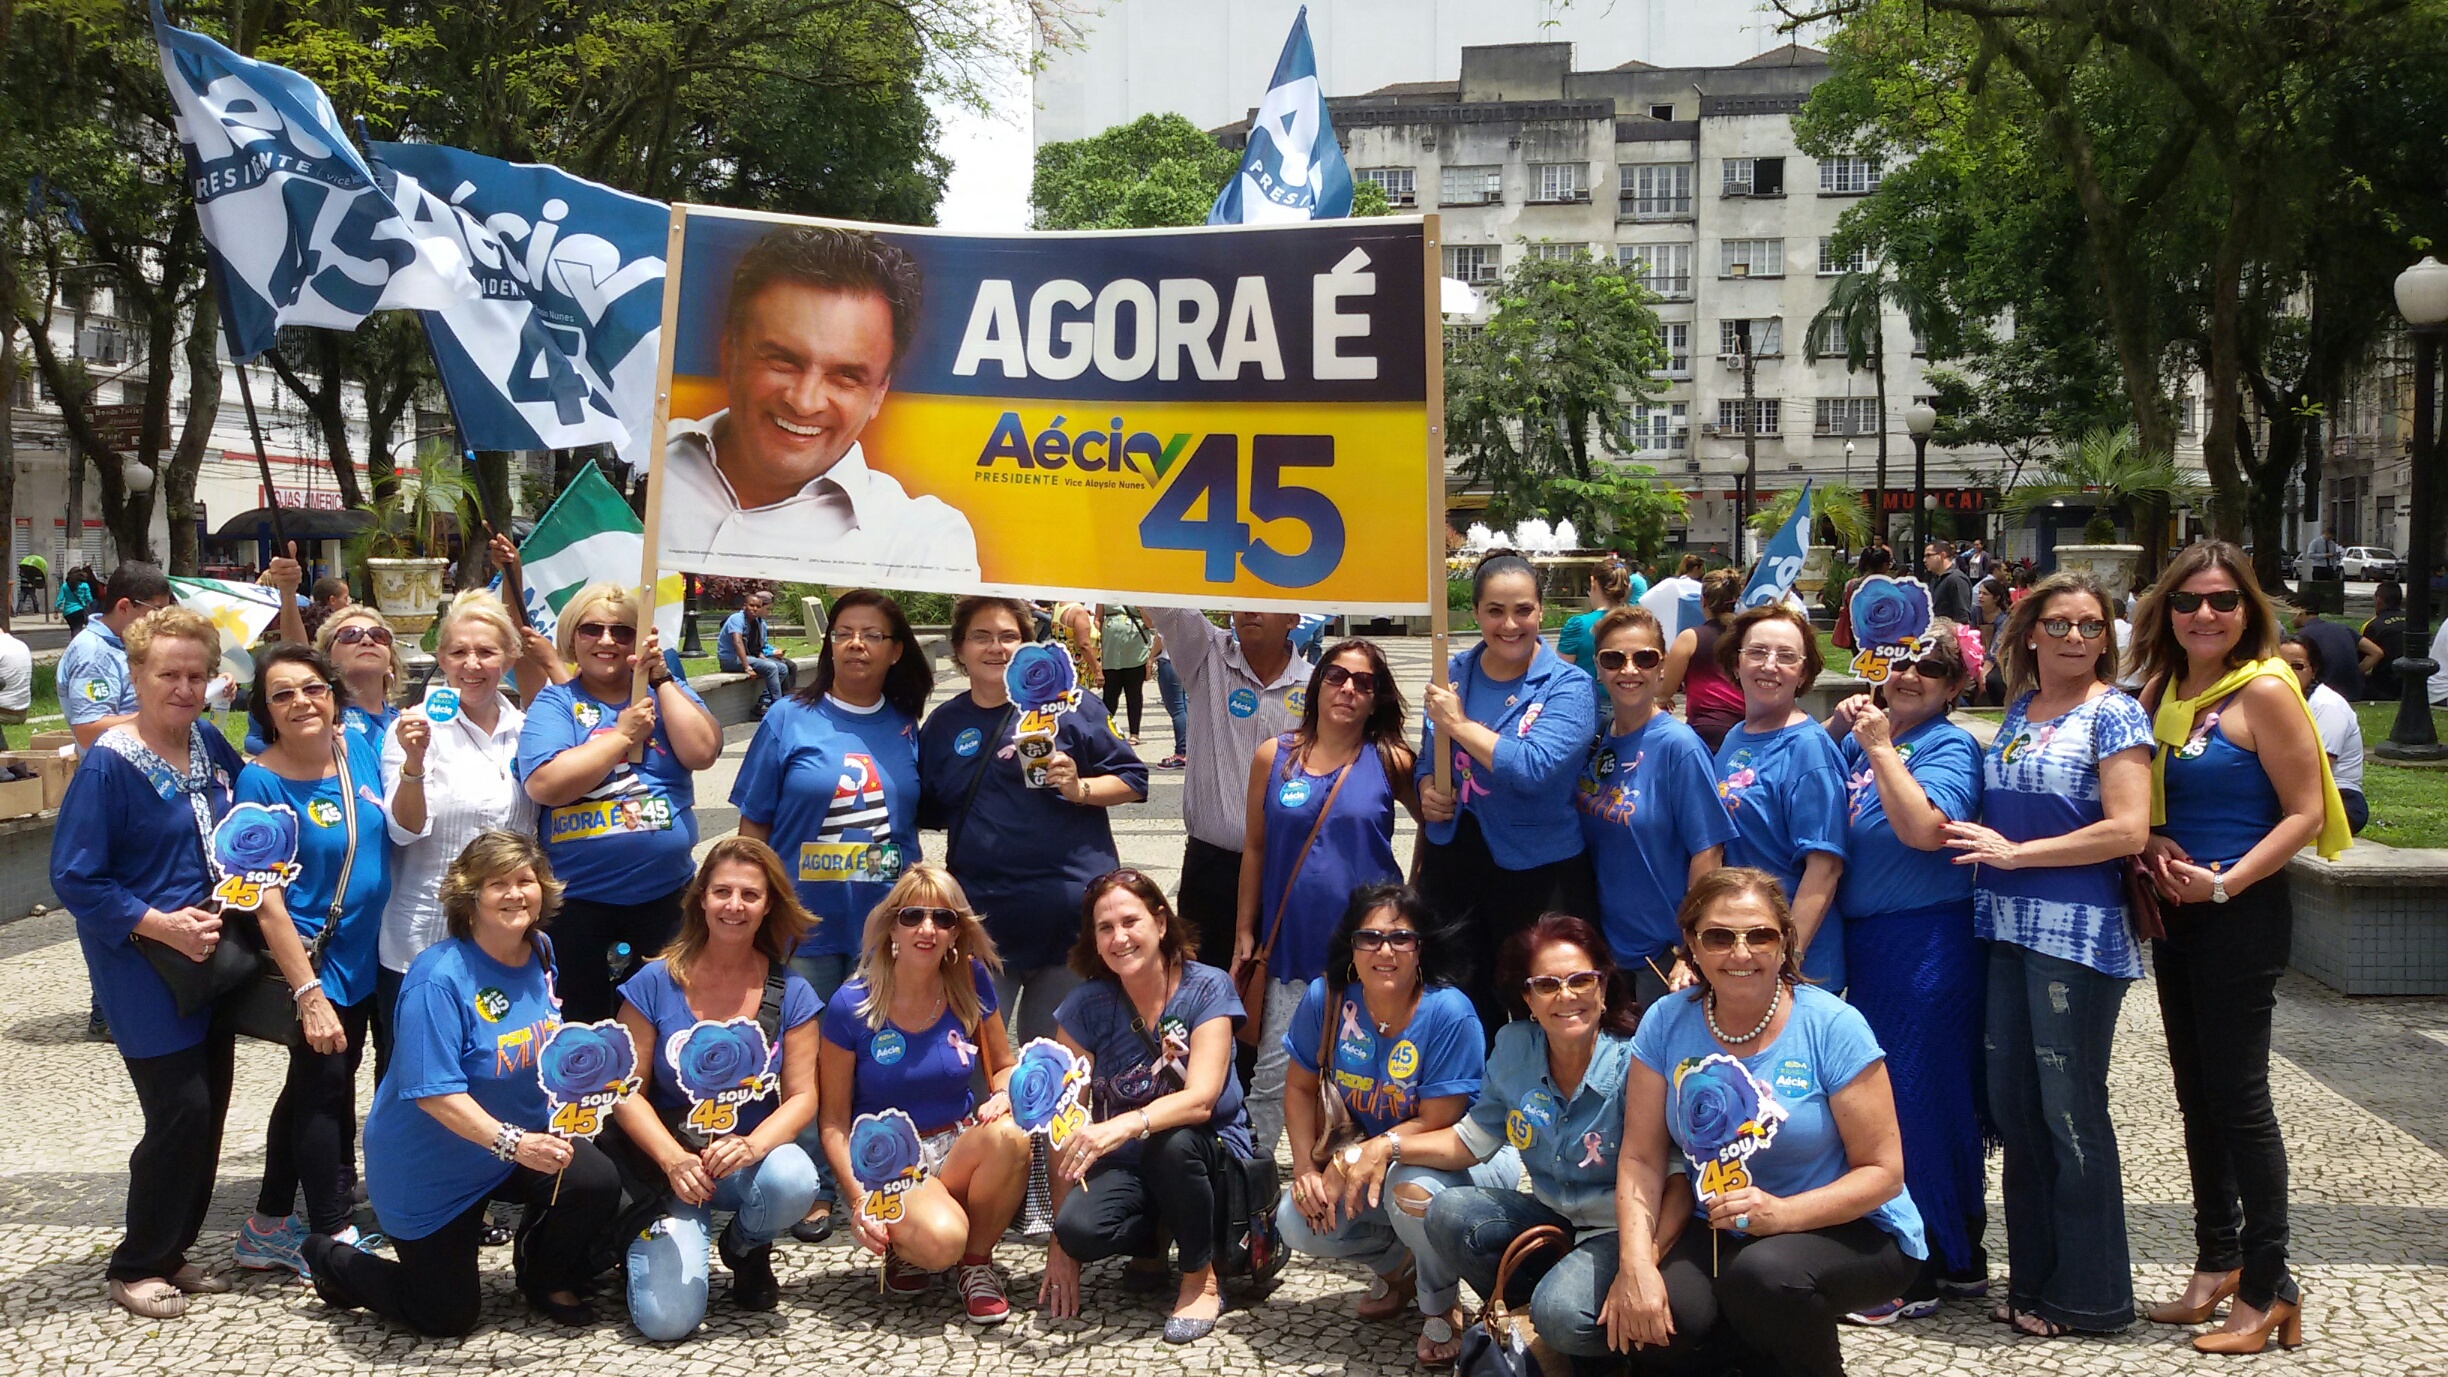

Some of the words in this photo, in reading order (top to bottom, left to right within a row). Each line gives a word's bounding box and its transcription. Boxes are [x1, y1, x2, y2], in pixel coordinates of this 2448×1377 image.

[195, 152, 313, 199] RESINTE
[394, 169, 622, 299] Aécio
[952, 275, 1286, 381] AGORA
[1313, 246, 1378, 380] É
[976, 412, 1163, 474] Aécio
[974, 471, 1059, 486] PRESIDENTE
[1064, 478, 1083, 487] Vice
[1084, 479, 1117, 490] Aloysio
[1118, 480, 1146, 490] Nunes
[274, 490, 300, 508] OJAS
[304, 492, 347, 511] AMERIC
[1139, 433, 1346, 589] 45
[1883, 492, 1982, 509] MUICA
[1875, 646, 1906, 658] SOU
[1853, 651, 1889, 681] 45
[93, 686, 109, 698] 45
[1040, 701, 1065, 714] SOU
[1020, 710, 1056, 736] 45
[1027, 742, 1043, 758] 45
[1033, 767, 1047, 786] 45
[1600, 758, 1616, 774] 45
[552, 809, 607, 836] AGORA
[610, 804, 623, 827] É
[641, 800, 670, 822] 45
[802, 853, 853, 871] AGORA
[855, 850, 868, 870] É
[880, 850, 900, 869] 45
[246, 871, 278, 883] SOU
[217, 876, 260, 907] 45
[489, 994, 510, 1016] 45
[1341, 1041, 1368, 1060] Aécio
[1391, 1045, 1413, 1065] 45
[1775, 1074, 1808, 1089] Aécio
[580, 1092, 613, 1108] SOU
[717, 1088, 748, 1104] SOU
[1056, 1082, 1077, 1114] SOU
[553, 1102, 598, 1135] 45
[690, 1098, 734, 1130] 45
[1522, 1103, 1550, 1121] Aécio
[1052, 1102, 1086, 1145] 45
[1718, 1137, 1751, 1163] SOU
[883, 1178, 910, 1195] SOU
[1701, 1158, 1749, 1197] 45
[865, 1190, 903, 1221] 45
